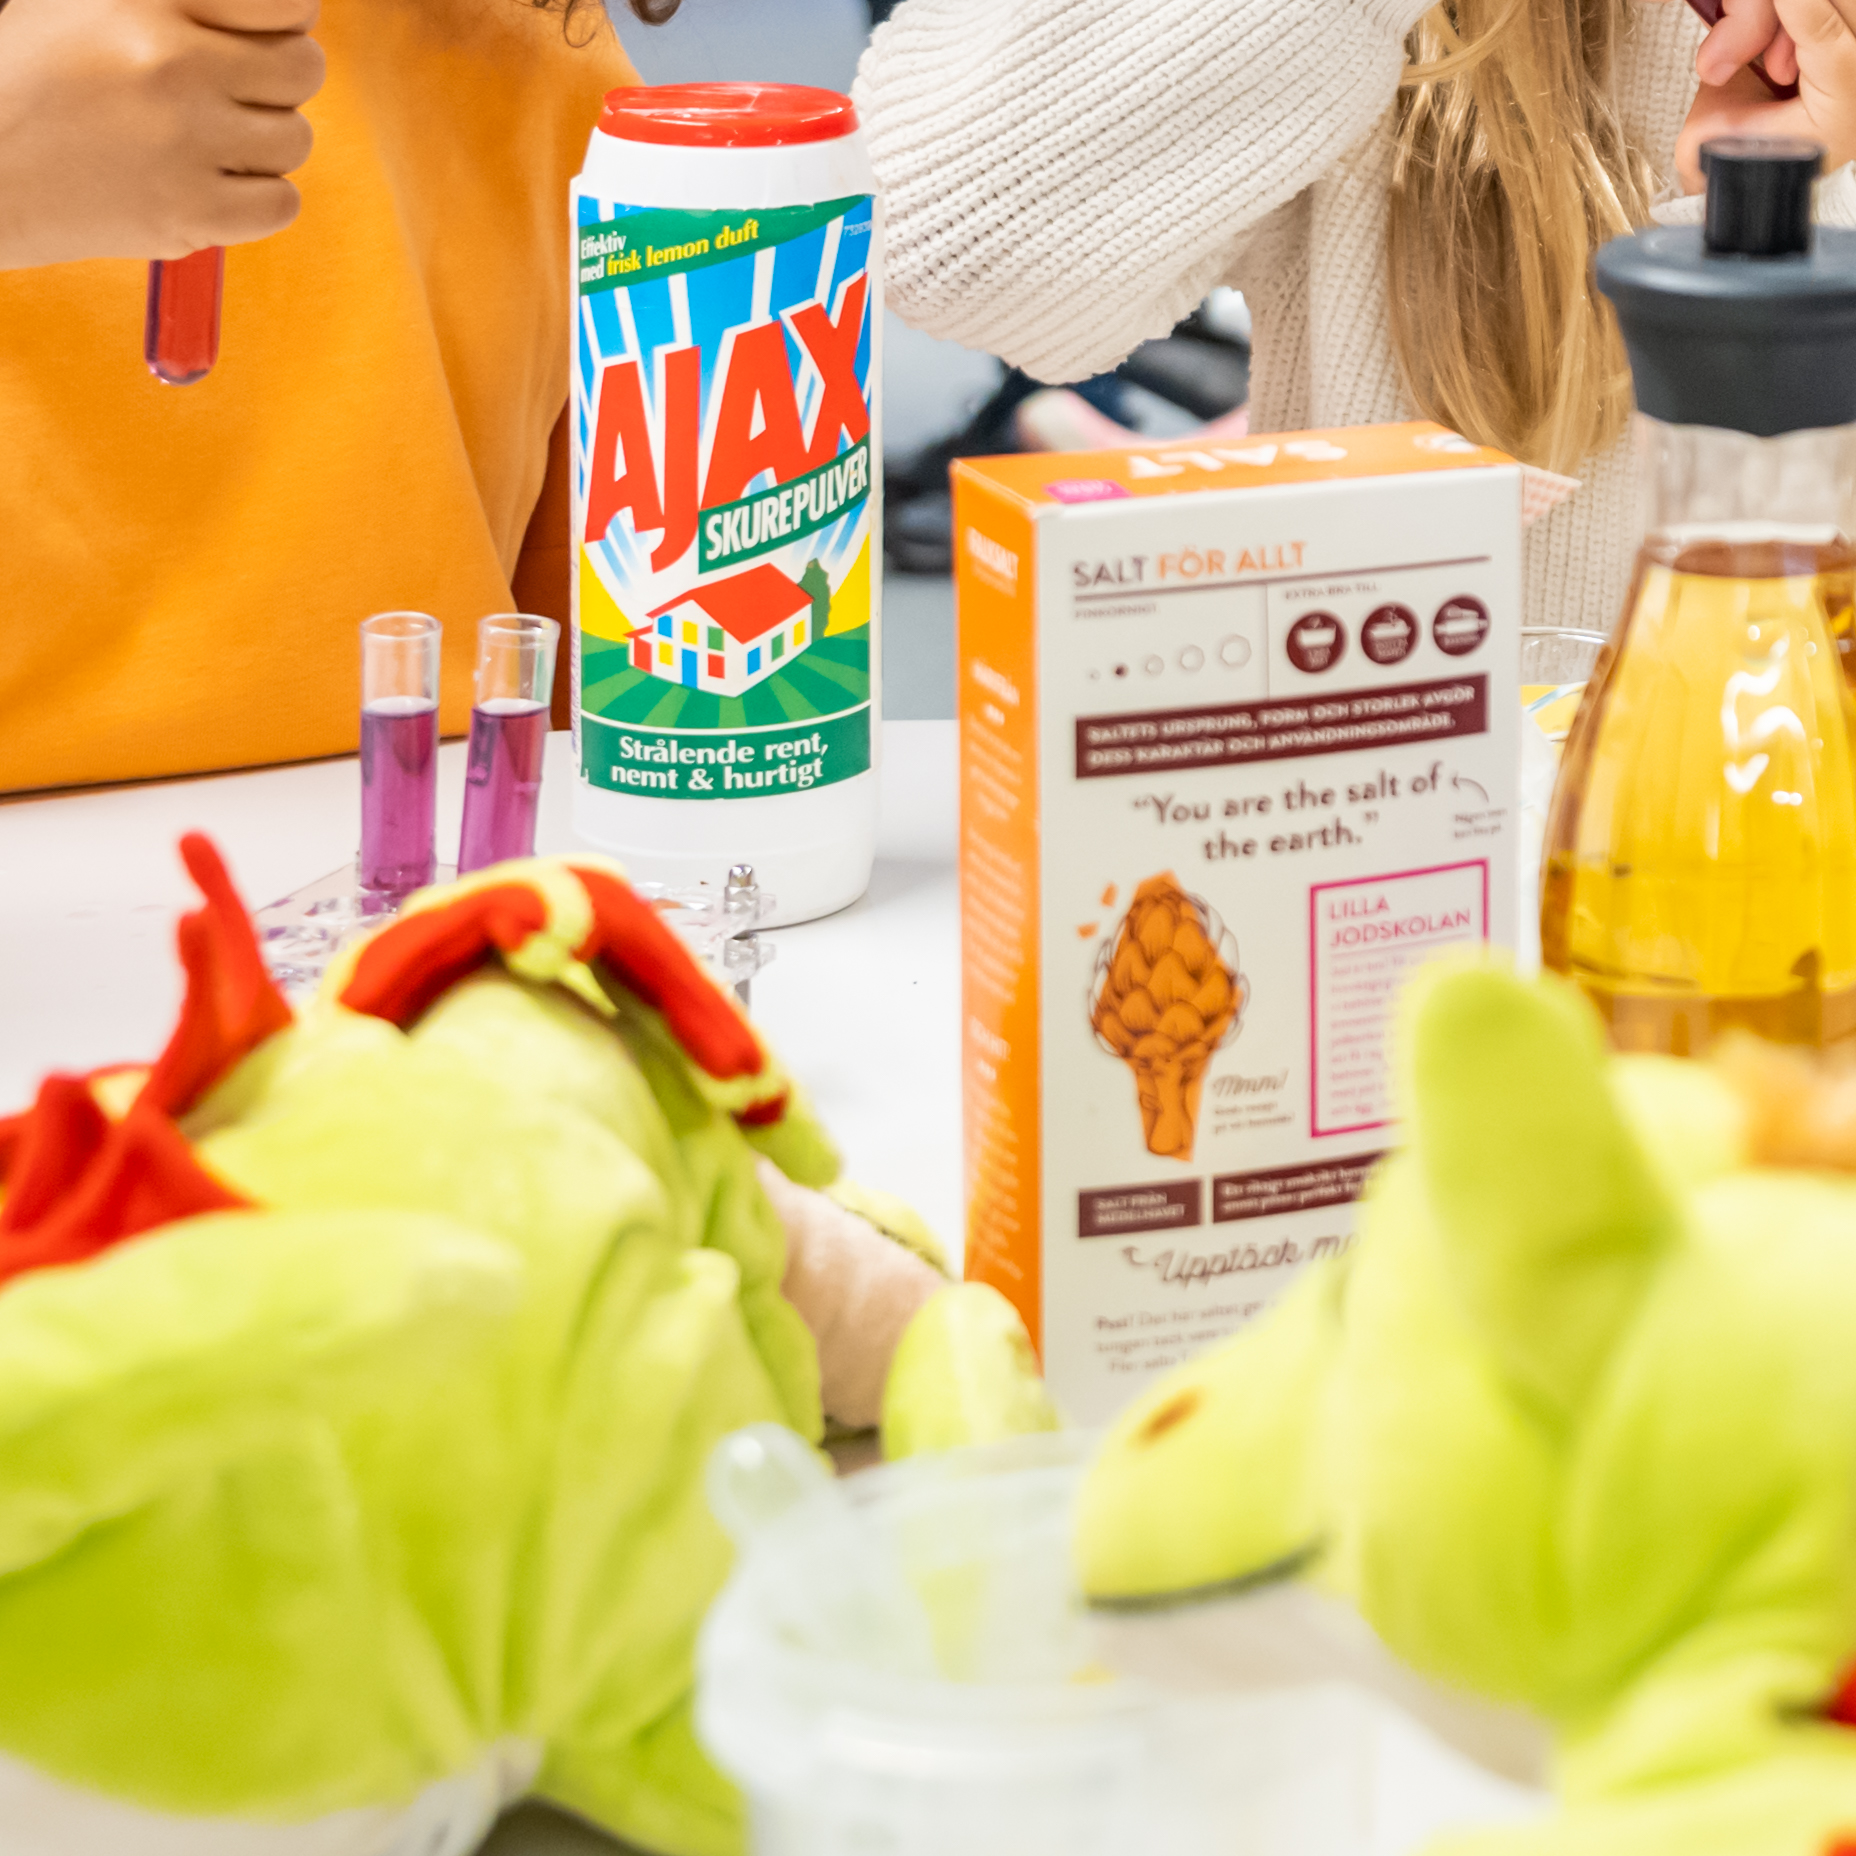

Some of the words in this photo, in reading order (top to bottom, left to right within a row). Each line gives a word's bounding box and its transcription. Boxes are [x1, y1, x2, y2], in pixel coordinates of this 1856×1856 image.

[580, 261, 604, 284] med
[606, 249, 642, 277] frisk
[646, 238, 709, 268] lemon
[714, 219, 760, 251] duft
[581, 231, 627, 260] Effektiv
[584, 270, 871, 575] AJAX
[705, 445, 868, 561] SKUREPULVER
[1072, 556, 1149, 588] SALT
[1157, 546, 1226, 581] FÖR
[1236, 541, 1309, 574] ALLT
[1085, 721, 1158, 745] SALTETS
[1258, 706, 1309, 726] FORM
[1310, 702, 1350, 723] OCH
[1350, 693, 1421, 719] STORLEK
[619, 735, 755, 765] Strålende
[764, 731, 829, 762] rent,
[1225, 735, 1266, 755] OCH
[610, 764, 679, 790] nemt
[687, 768, 715, 791] &
[723, 756, 824, 788] hurtigt
[1224, 795, 1273, 818] are
[1284, 779, 1336, 813] the
[1347, 768, 1399, 803] salt
[1411, 760, 1444, 794] of
[1204, 829, 1258, 861] the
[1329, 895, 1391, 921] LILLA
[1329, 908, 1472, 947] JODSKOLAN
